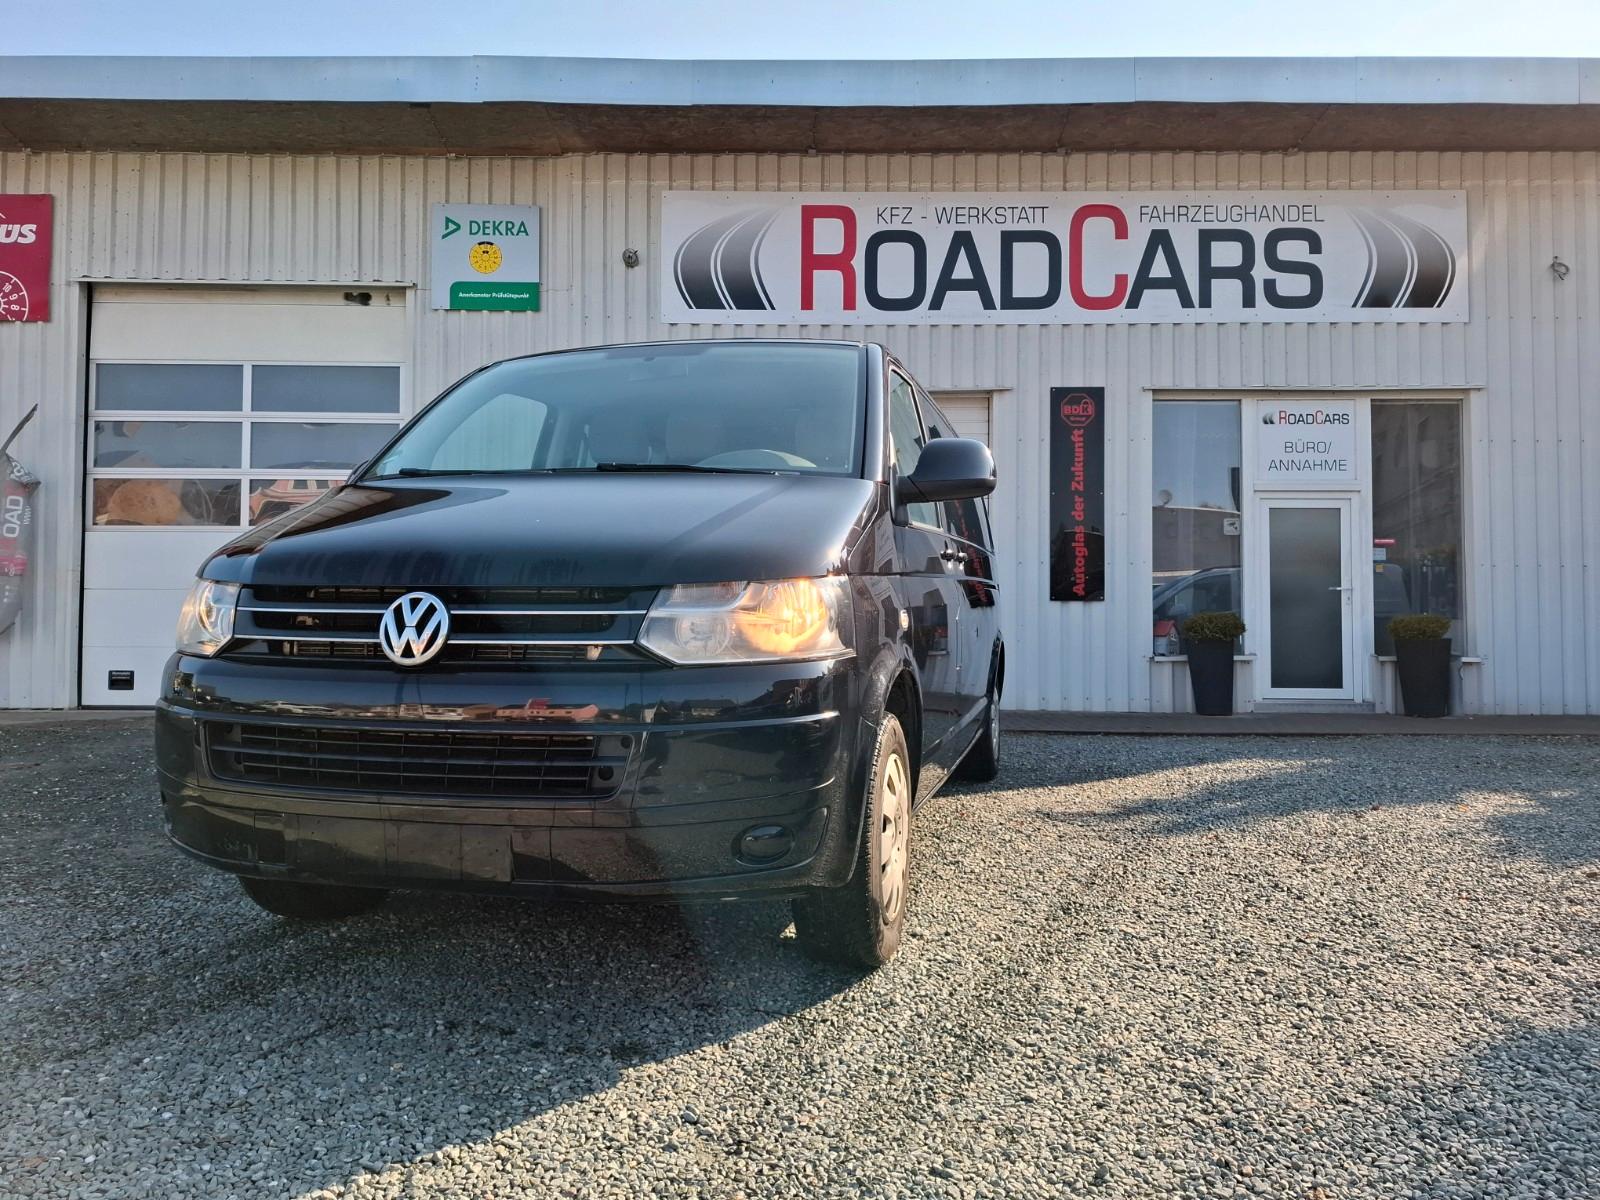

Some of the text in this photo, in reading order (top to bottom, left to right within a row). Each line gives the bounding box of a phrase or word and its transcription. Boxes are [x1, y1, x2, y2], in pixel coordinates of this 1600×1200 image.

[876, 207, 913, 224] KFZ
[935, 207, 1049, 224] WERKSTATT
[1139, 205, 1325, 223] FAHRZEUGHANDEL
[469, 221, 529, 236] DEKRA
[1284, 438, 1332, 454] BÜRO/
[1072, 429, 1084, 491] Zukunft
[1268, 460, 1347, 471] ANNAHME
[1072, 496, 1084, 521] der
[1073, 525, 1088, 596] Autoglas
[382, 594, 446, 664] VW
